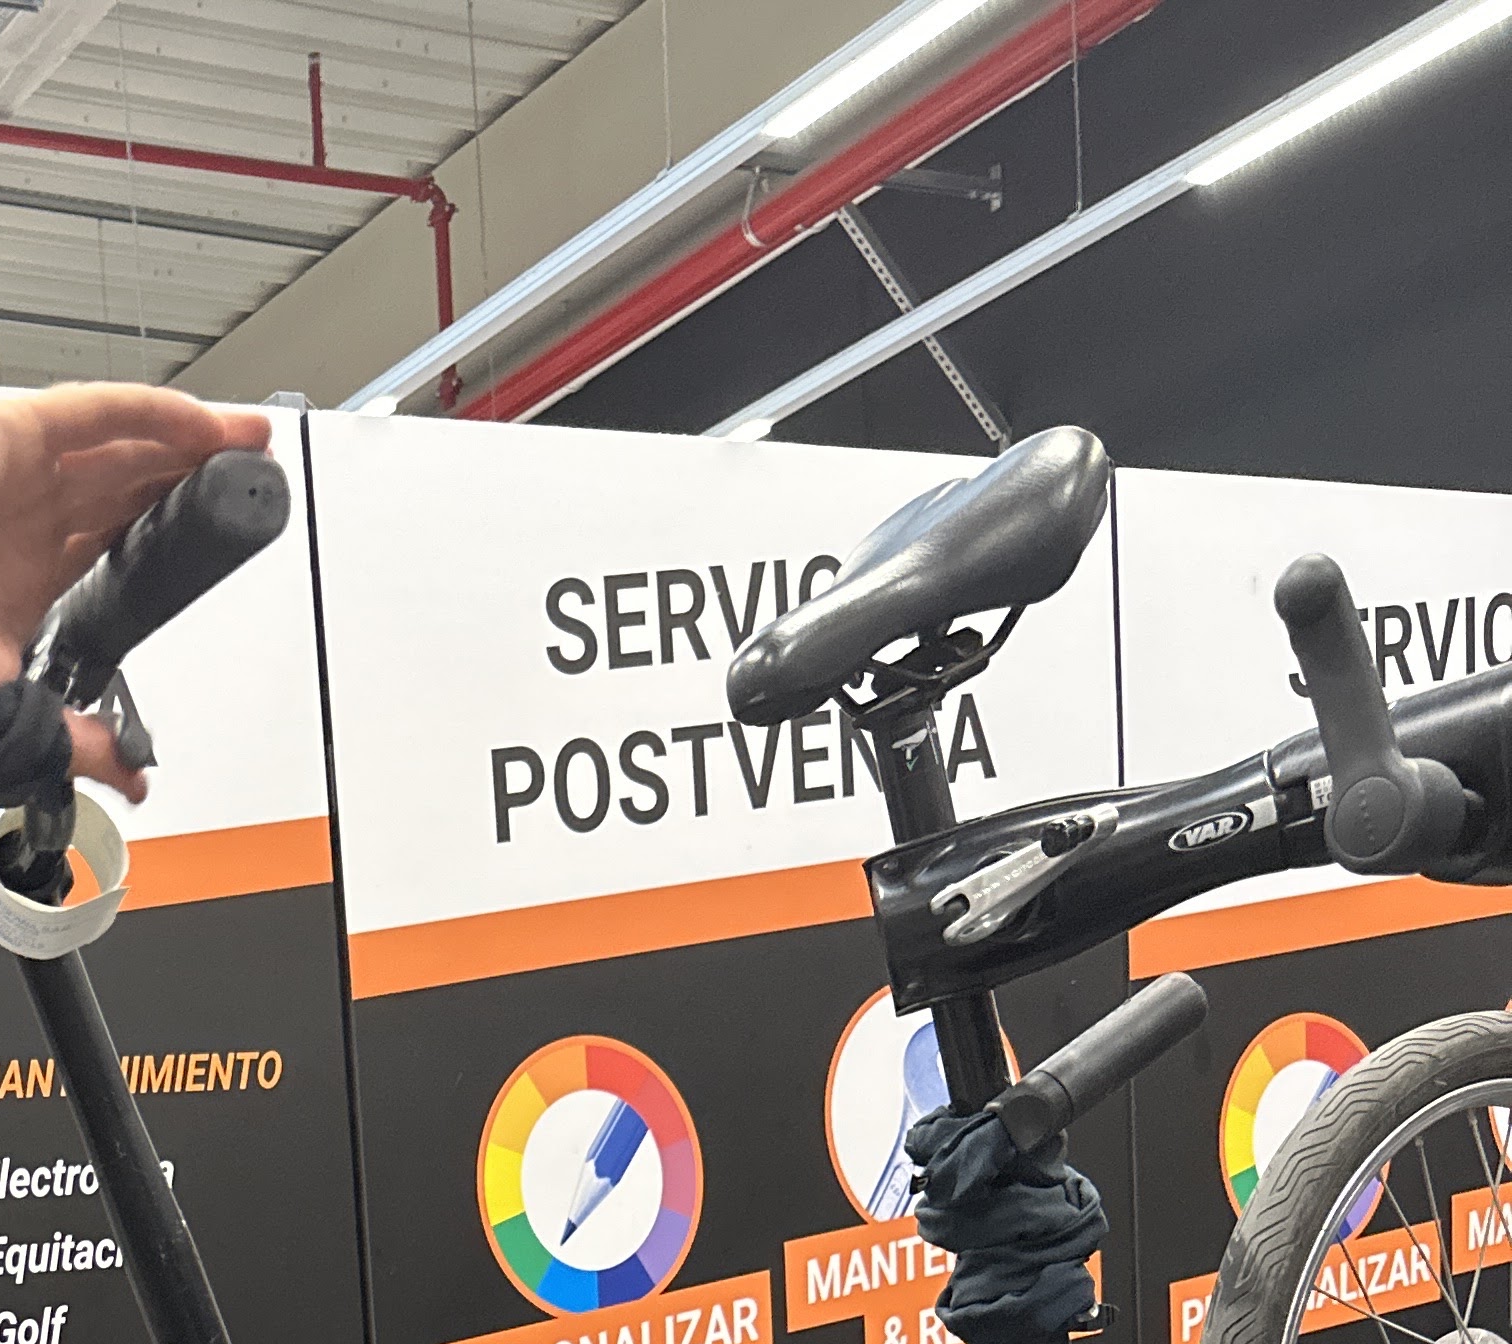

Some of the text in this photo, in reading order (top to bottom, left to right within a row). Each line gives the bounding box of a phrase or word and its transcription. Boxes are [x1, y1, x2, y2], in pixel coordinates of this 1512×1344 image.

[491, 693, 997, 844] POSTVENA
[1182, 816, 1235, 847] VAR
[807, 1235, 958, 1305] MANTE
